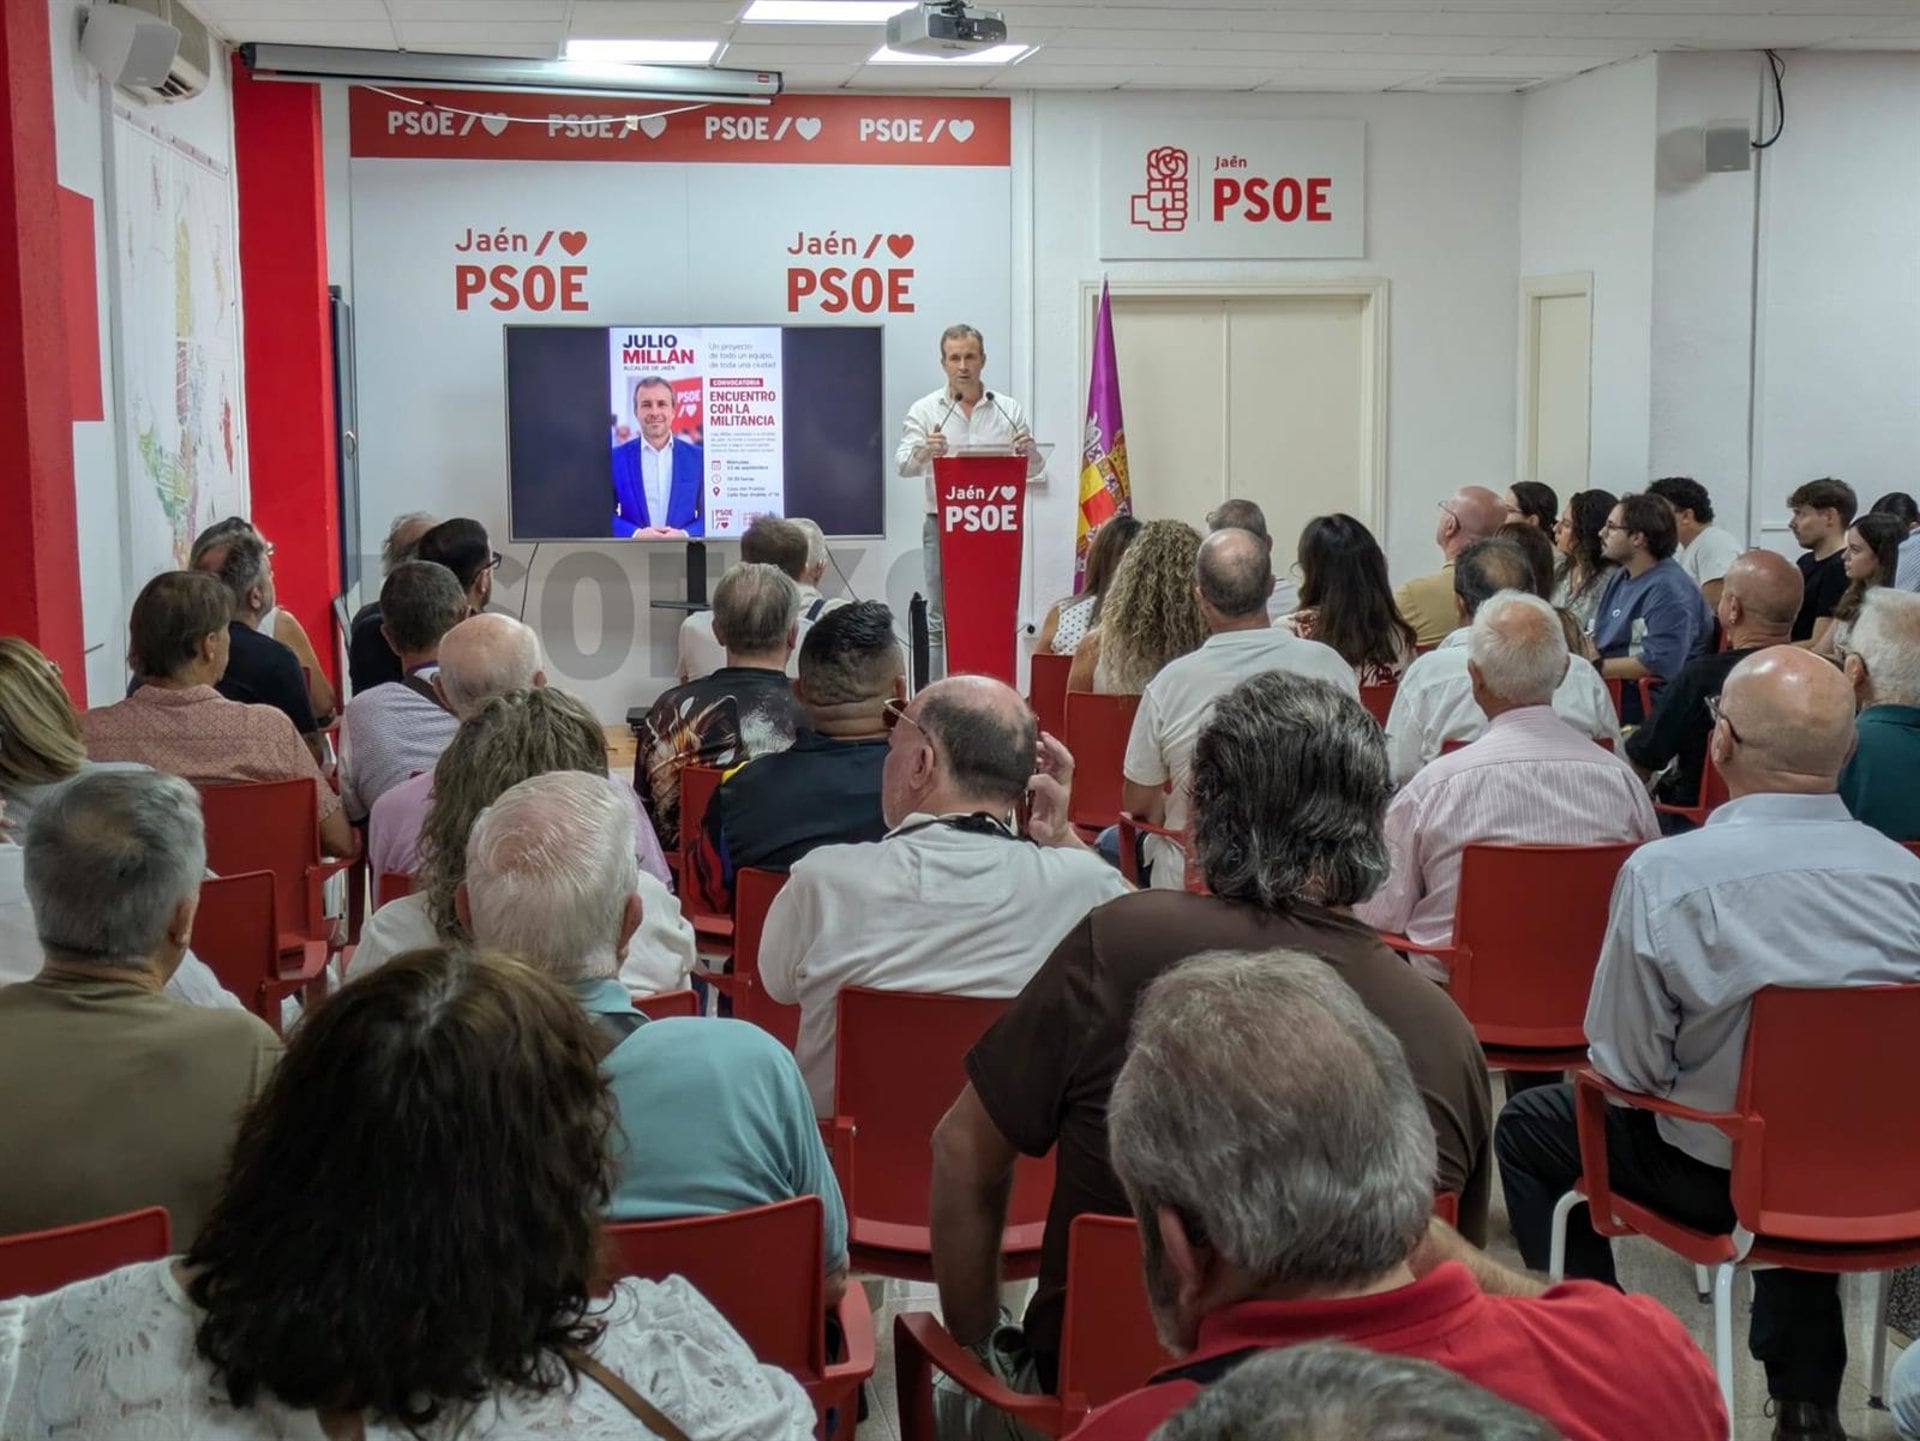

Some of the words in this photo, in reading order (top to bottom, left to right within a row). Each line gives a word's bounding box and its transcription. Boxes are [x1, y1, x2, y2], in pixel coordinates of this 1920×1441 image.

[388, 111, 454, 137] PSOE
[548, 114, 613, 139] PSOE
[705, 116, 769, 141] PSOE
[859, 118, 923, 143] PSOE
[1215, 155, 1247, 171] Jaén
[1213, 177, 1332, 222] PSOE
[455, 226, 528, 253] Jaén
[787, 231, 857, 256] Jaén
[455, 265, 589, 312] PSOE
[787, 267, 915, 314] PSOE
[623, 334, 677, 348] JULIO
[677, 390, 702, 403] PSOE
[710, 391, 776, 402] ENCUENTRO
[710, 403, 733, 414] CON
[736, 403, 750, 414] LA
[710, 415, 775, 426] MILITANCIA
[945, 484, 985, 500] Jaén
[945, 505, 1018, 532] PSOE
